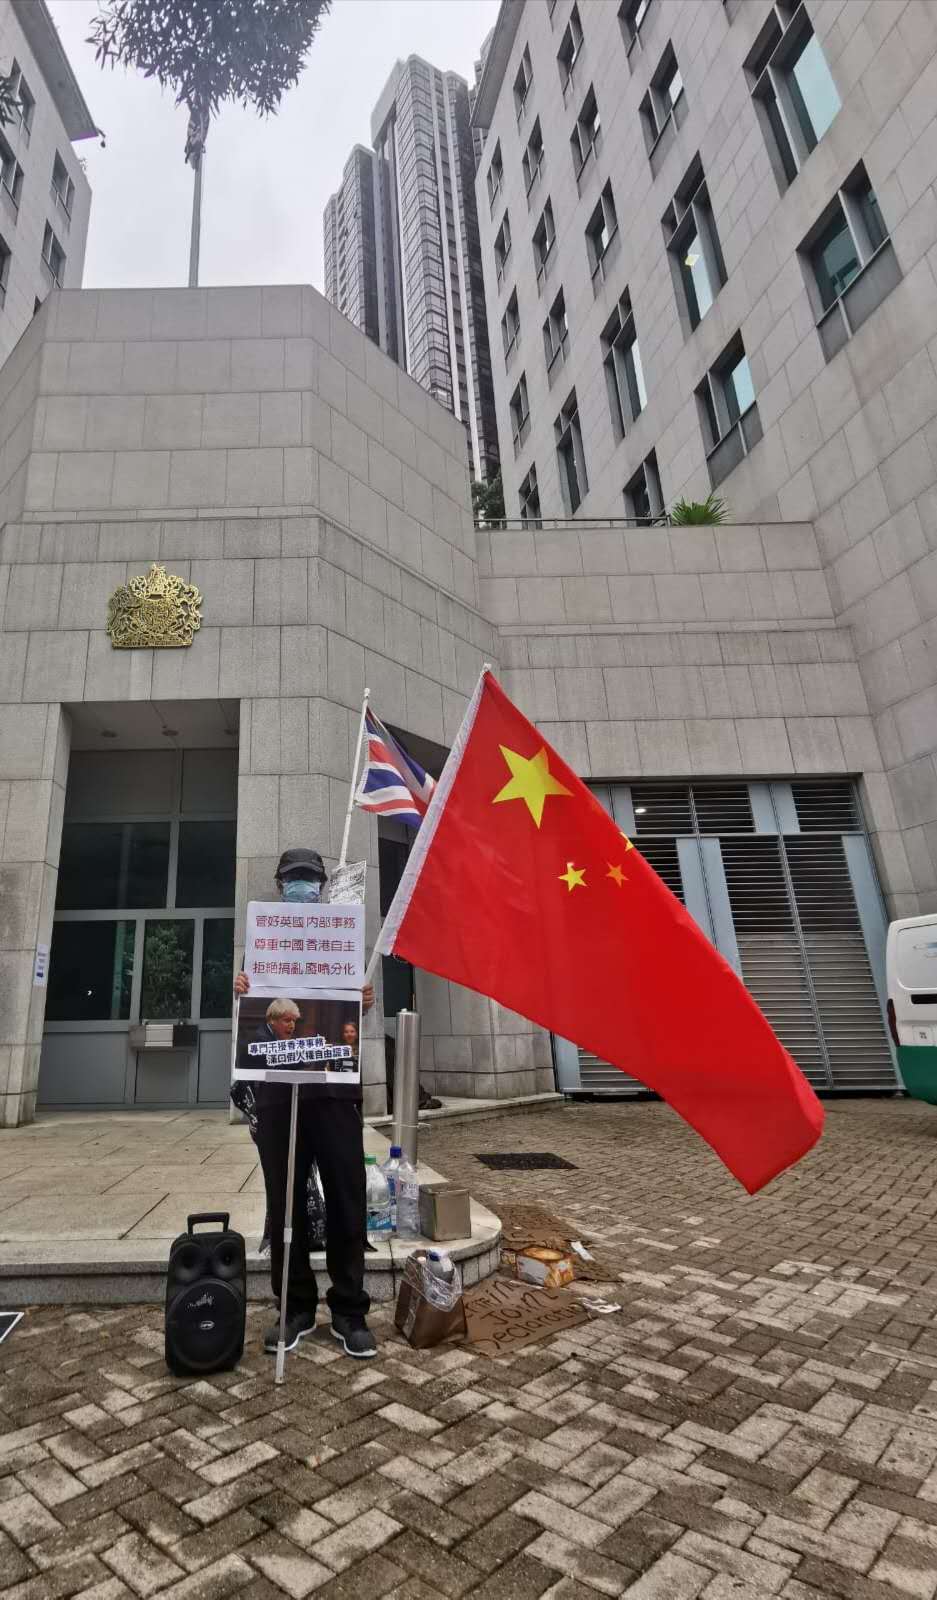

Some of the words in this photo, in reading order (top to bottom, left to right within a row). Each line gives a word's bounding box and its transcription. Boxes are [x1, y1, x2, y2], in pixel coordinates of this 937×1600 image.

[254, 938, 356, 952] 尊重中國香港自主
